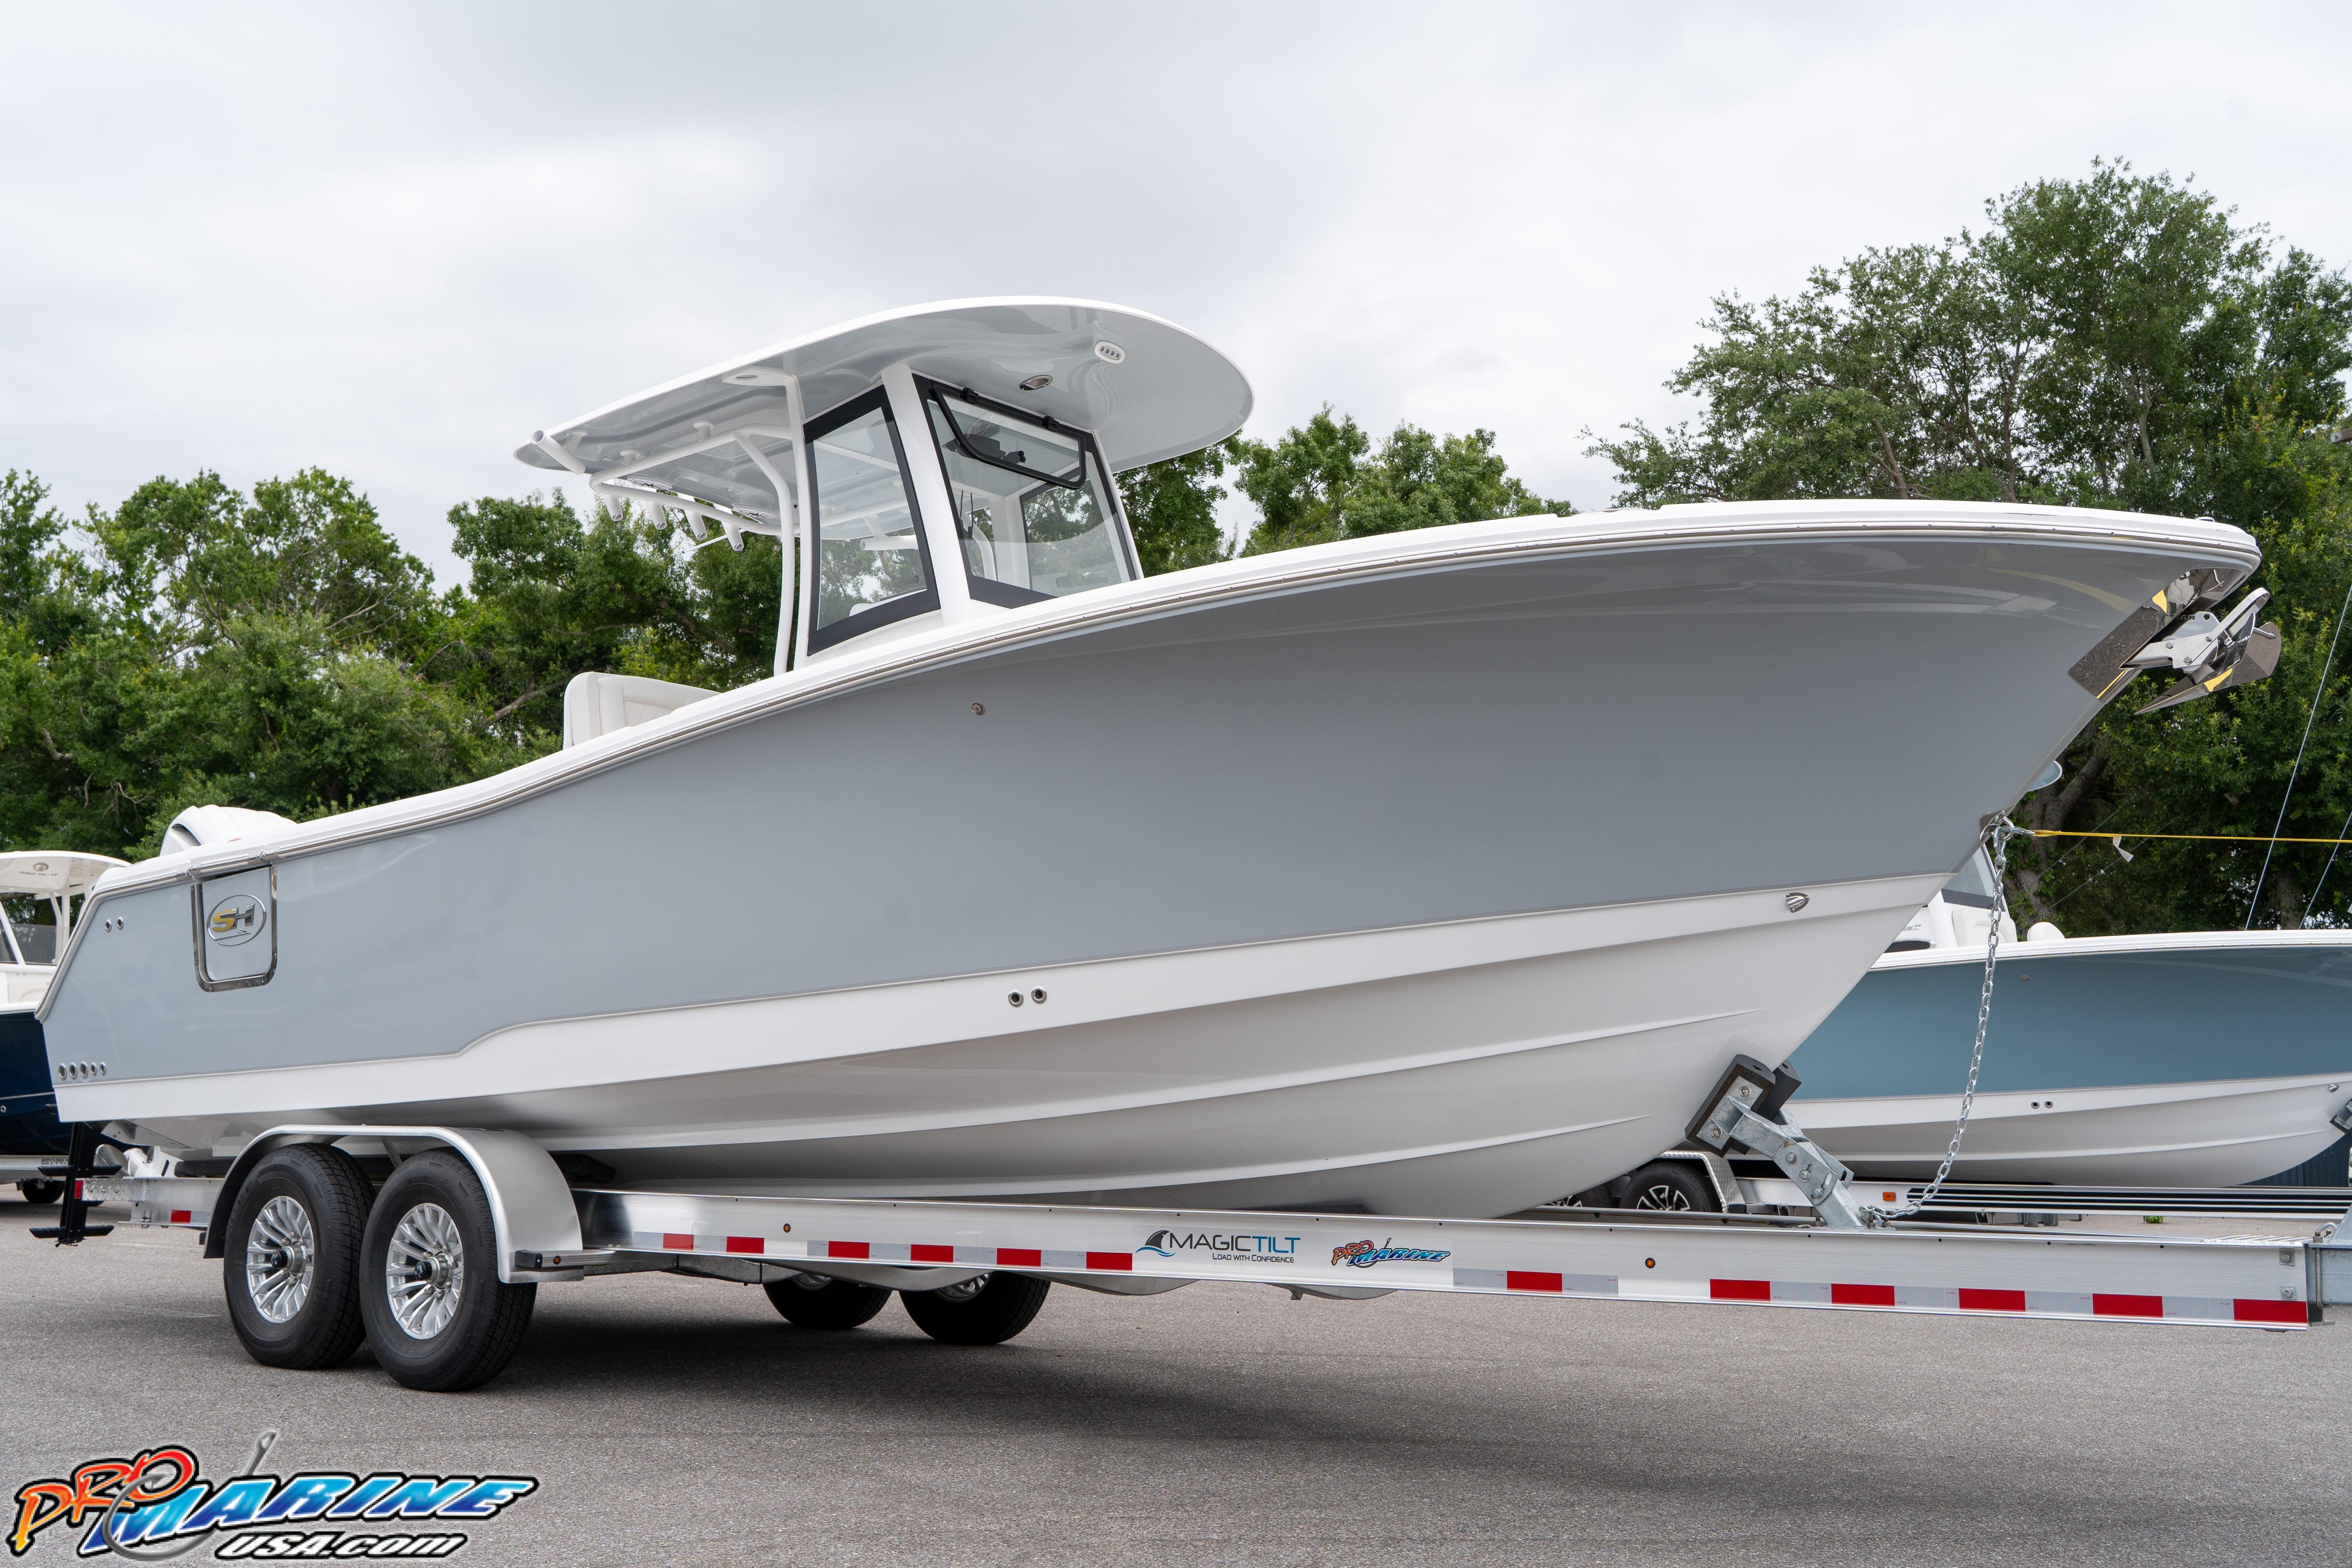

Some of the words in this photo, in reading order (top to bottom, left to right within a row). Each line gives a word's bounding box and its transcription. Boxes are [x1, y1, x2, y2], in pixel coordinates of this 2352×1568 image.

[1170, 1232, 1301, 1254] MAGICTILT
[1331, 1240, 1374, 1266] PRO
[1251, 1254, 1294, 1263] CONFIDENCE
[1347, 1248, 1451, 1267] MARINE
